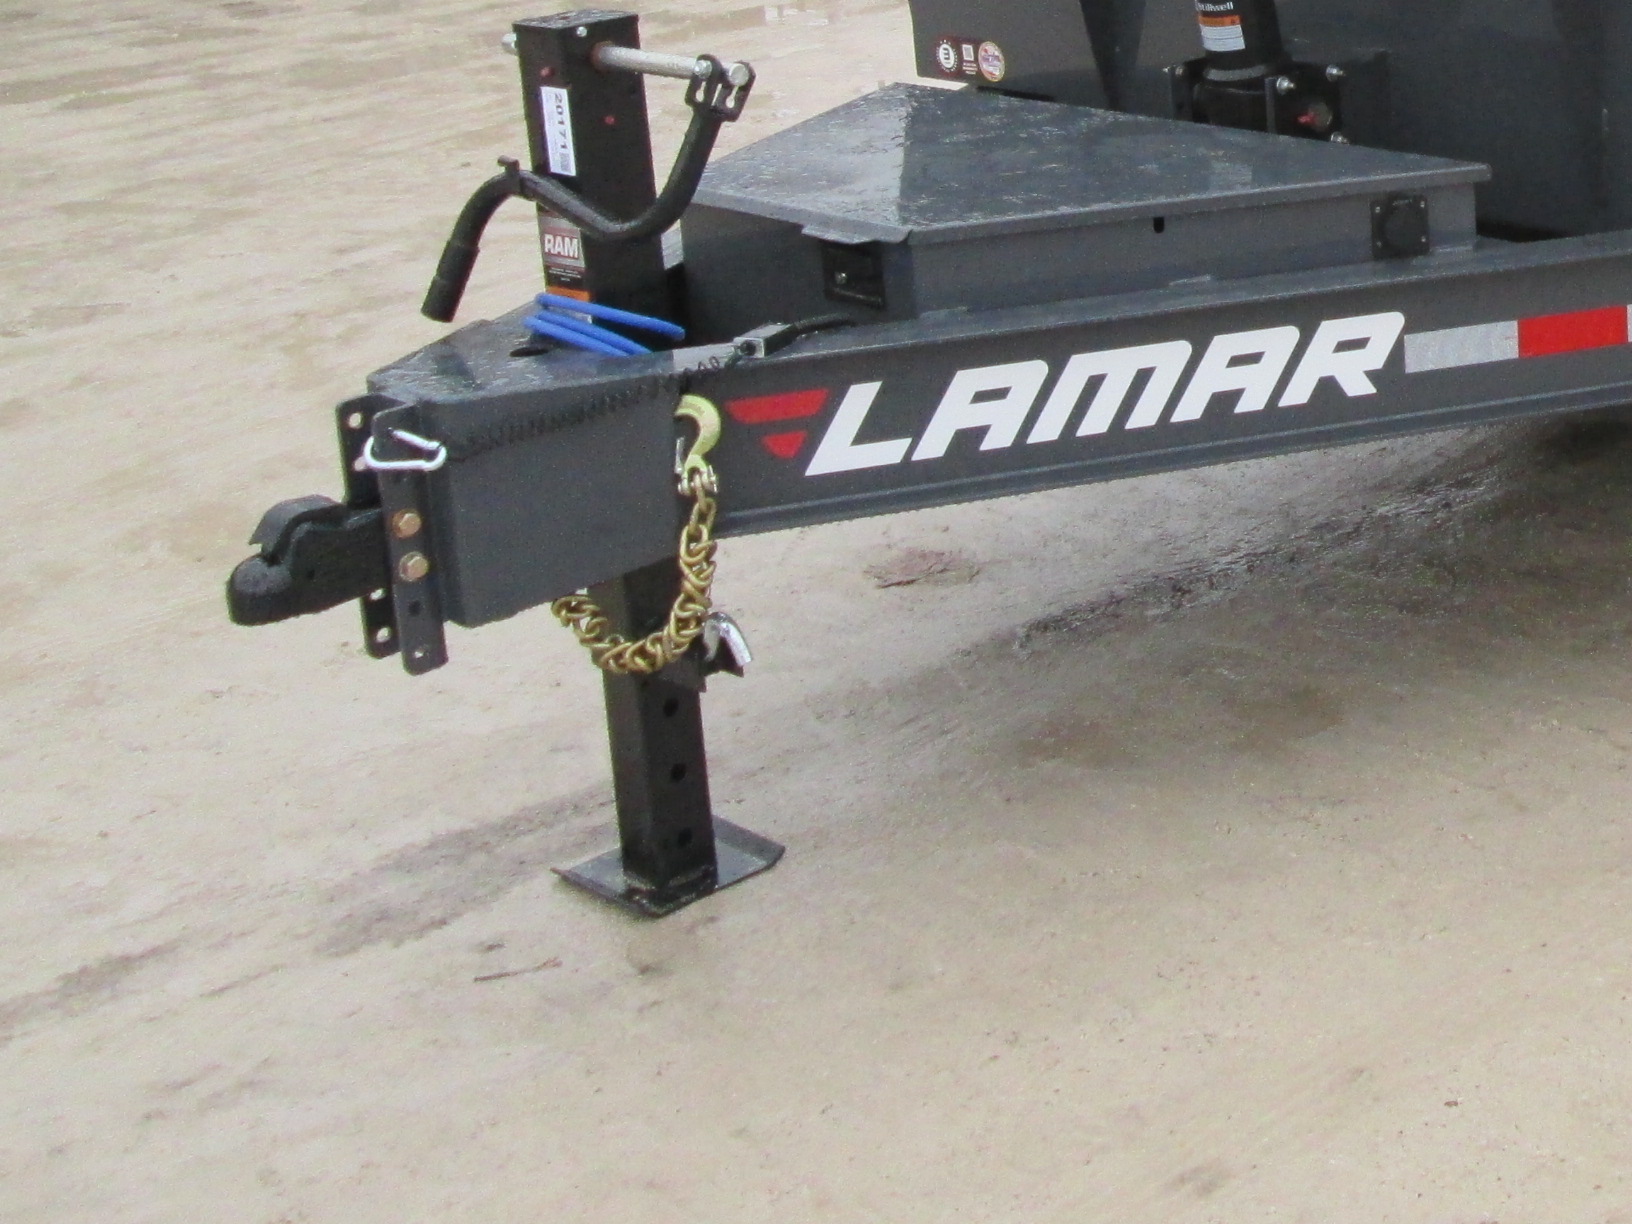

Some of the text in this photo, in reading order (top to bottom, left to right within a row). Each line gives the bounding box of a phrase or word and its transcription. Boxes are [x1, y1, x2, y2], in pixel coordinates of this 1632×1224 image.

[553, 92, 568, 150] 20171
[544, 233, 579, 258] RAM
[804, 311, 1406, 477] LAMAR
